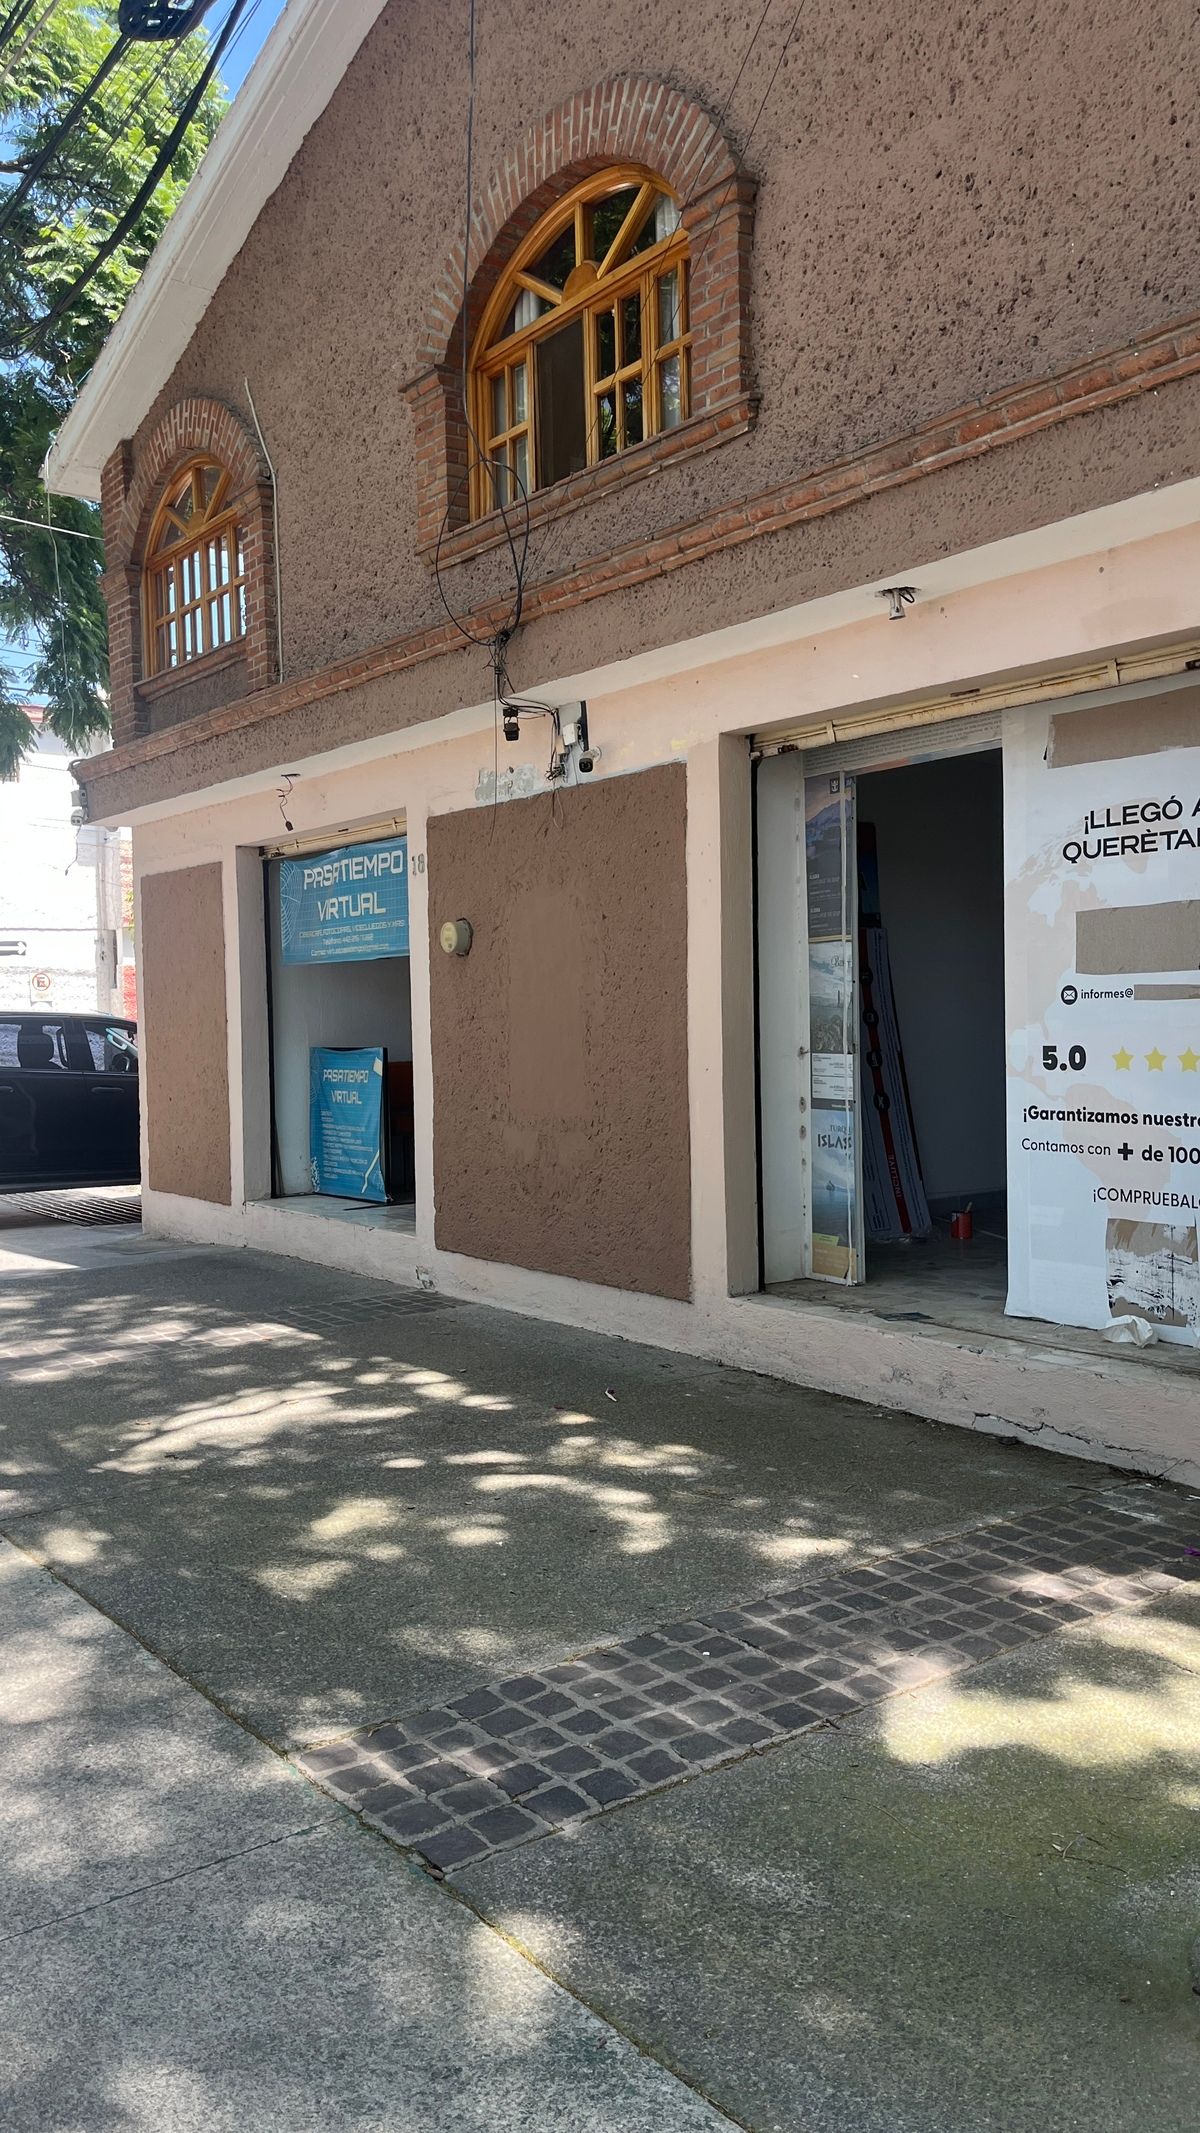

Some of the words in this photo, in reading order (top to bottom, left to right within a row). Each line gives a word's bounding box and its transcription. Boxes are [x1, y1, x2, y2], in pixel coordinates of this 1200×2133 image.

[1084, 795, 1183, 834] ¡LLEGÓ
[1062, 827, 1200, 864] QUERÈTA
[303, 850, 403, 890] PASATIEMPO
[317, 891, 387, 921] VIRTUAL
[1081, 987, 1134, 1000] informes@
[1042, 1045, 1087, 1071] 5.0
[323, 1069, 369, 1083] PASATIEMPO
[330, 1089, 362, 1104] VIRTUAL
[1023, 1105, 1139, 1125] ¡Garantizamos
[1021, 1137, 1085, 1154] Contamos
[1087, 1144, 1111, 1156] con
[1141, 1144, 1164, 1162] de
[1093, 1186, 1200, 1209] ¡COMPRUEBAL
